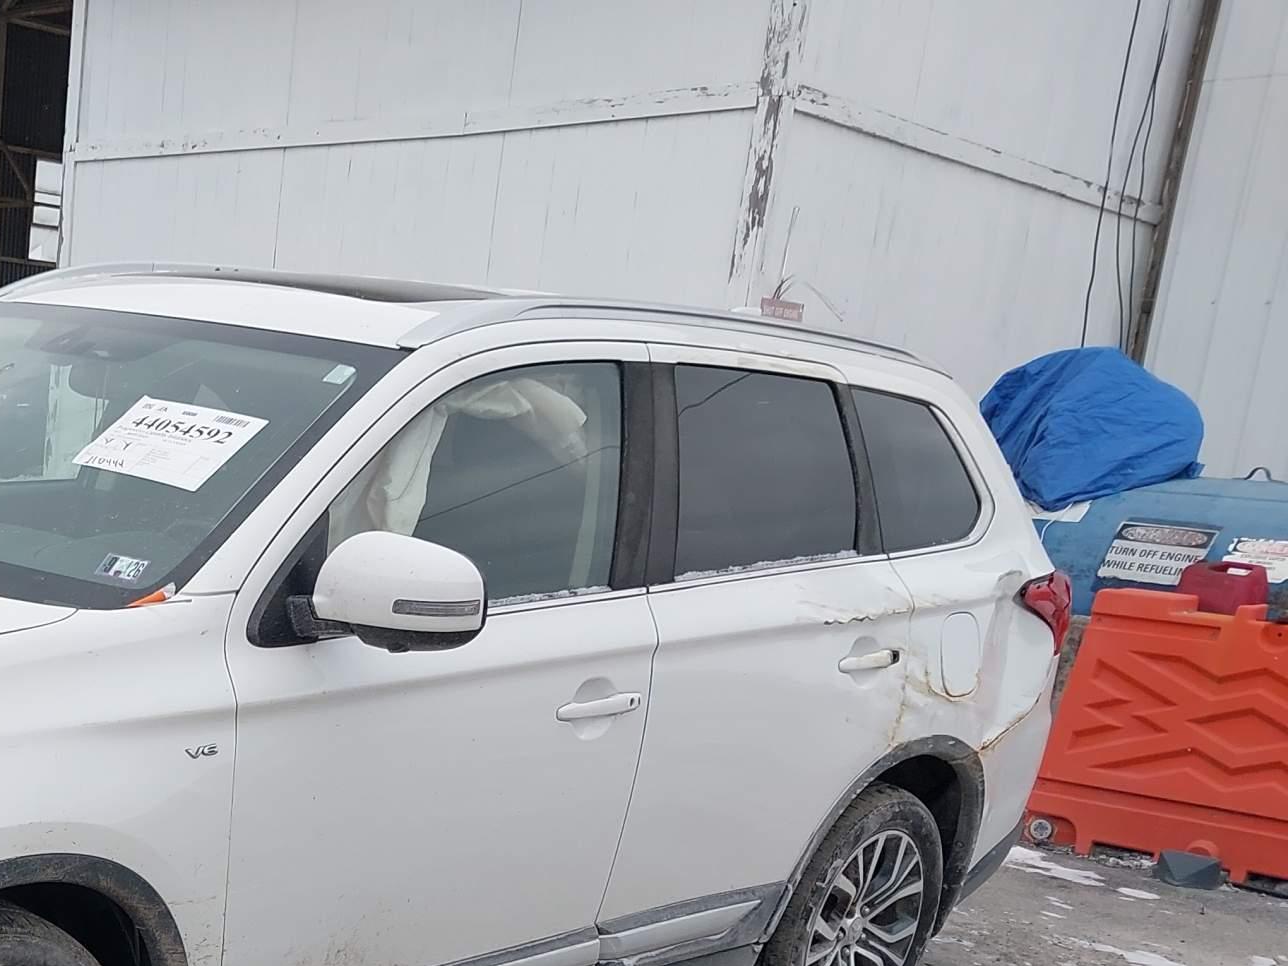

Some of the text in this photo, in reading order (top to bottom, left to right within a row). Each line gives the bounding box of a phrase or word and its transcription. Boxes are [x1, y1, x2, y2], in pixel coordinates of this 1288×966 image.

[132, 415, 233, 445] 44054592
[1109, 546, 1201, 563] TURN OFF ENGINE
[1103, 560, 1136, 571] WHILE
[184, 743, 219, 759] V6
